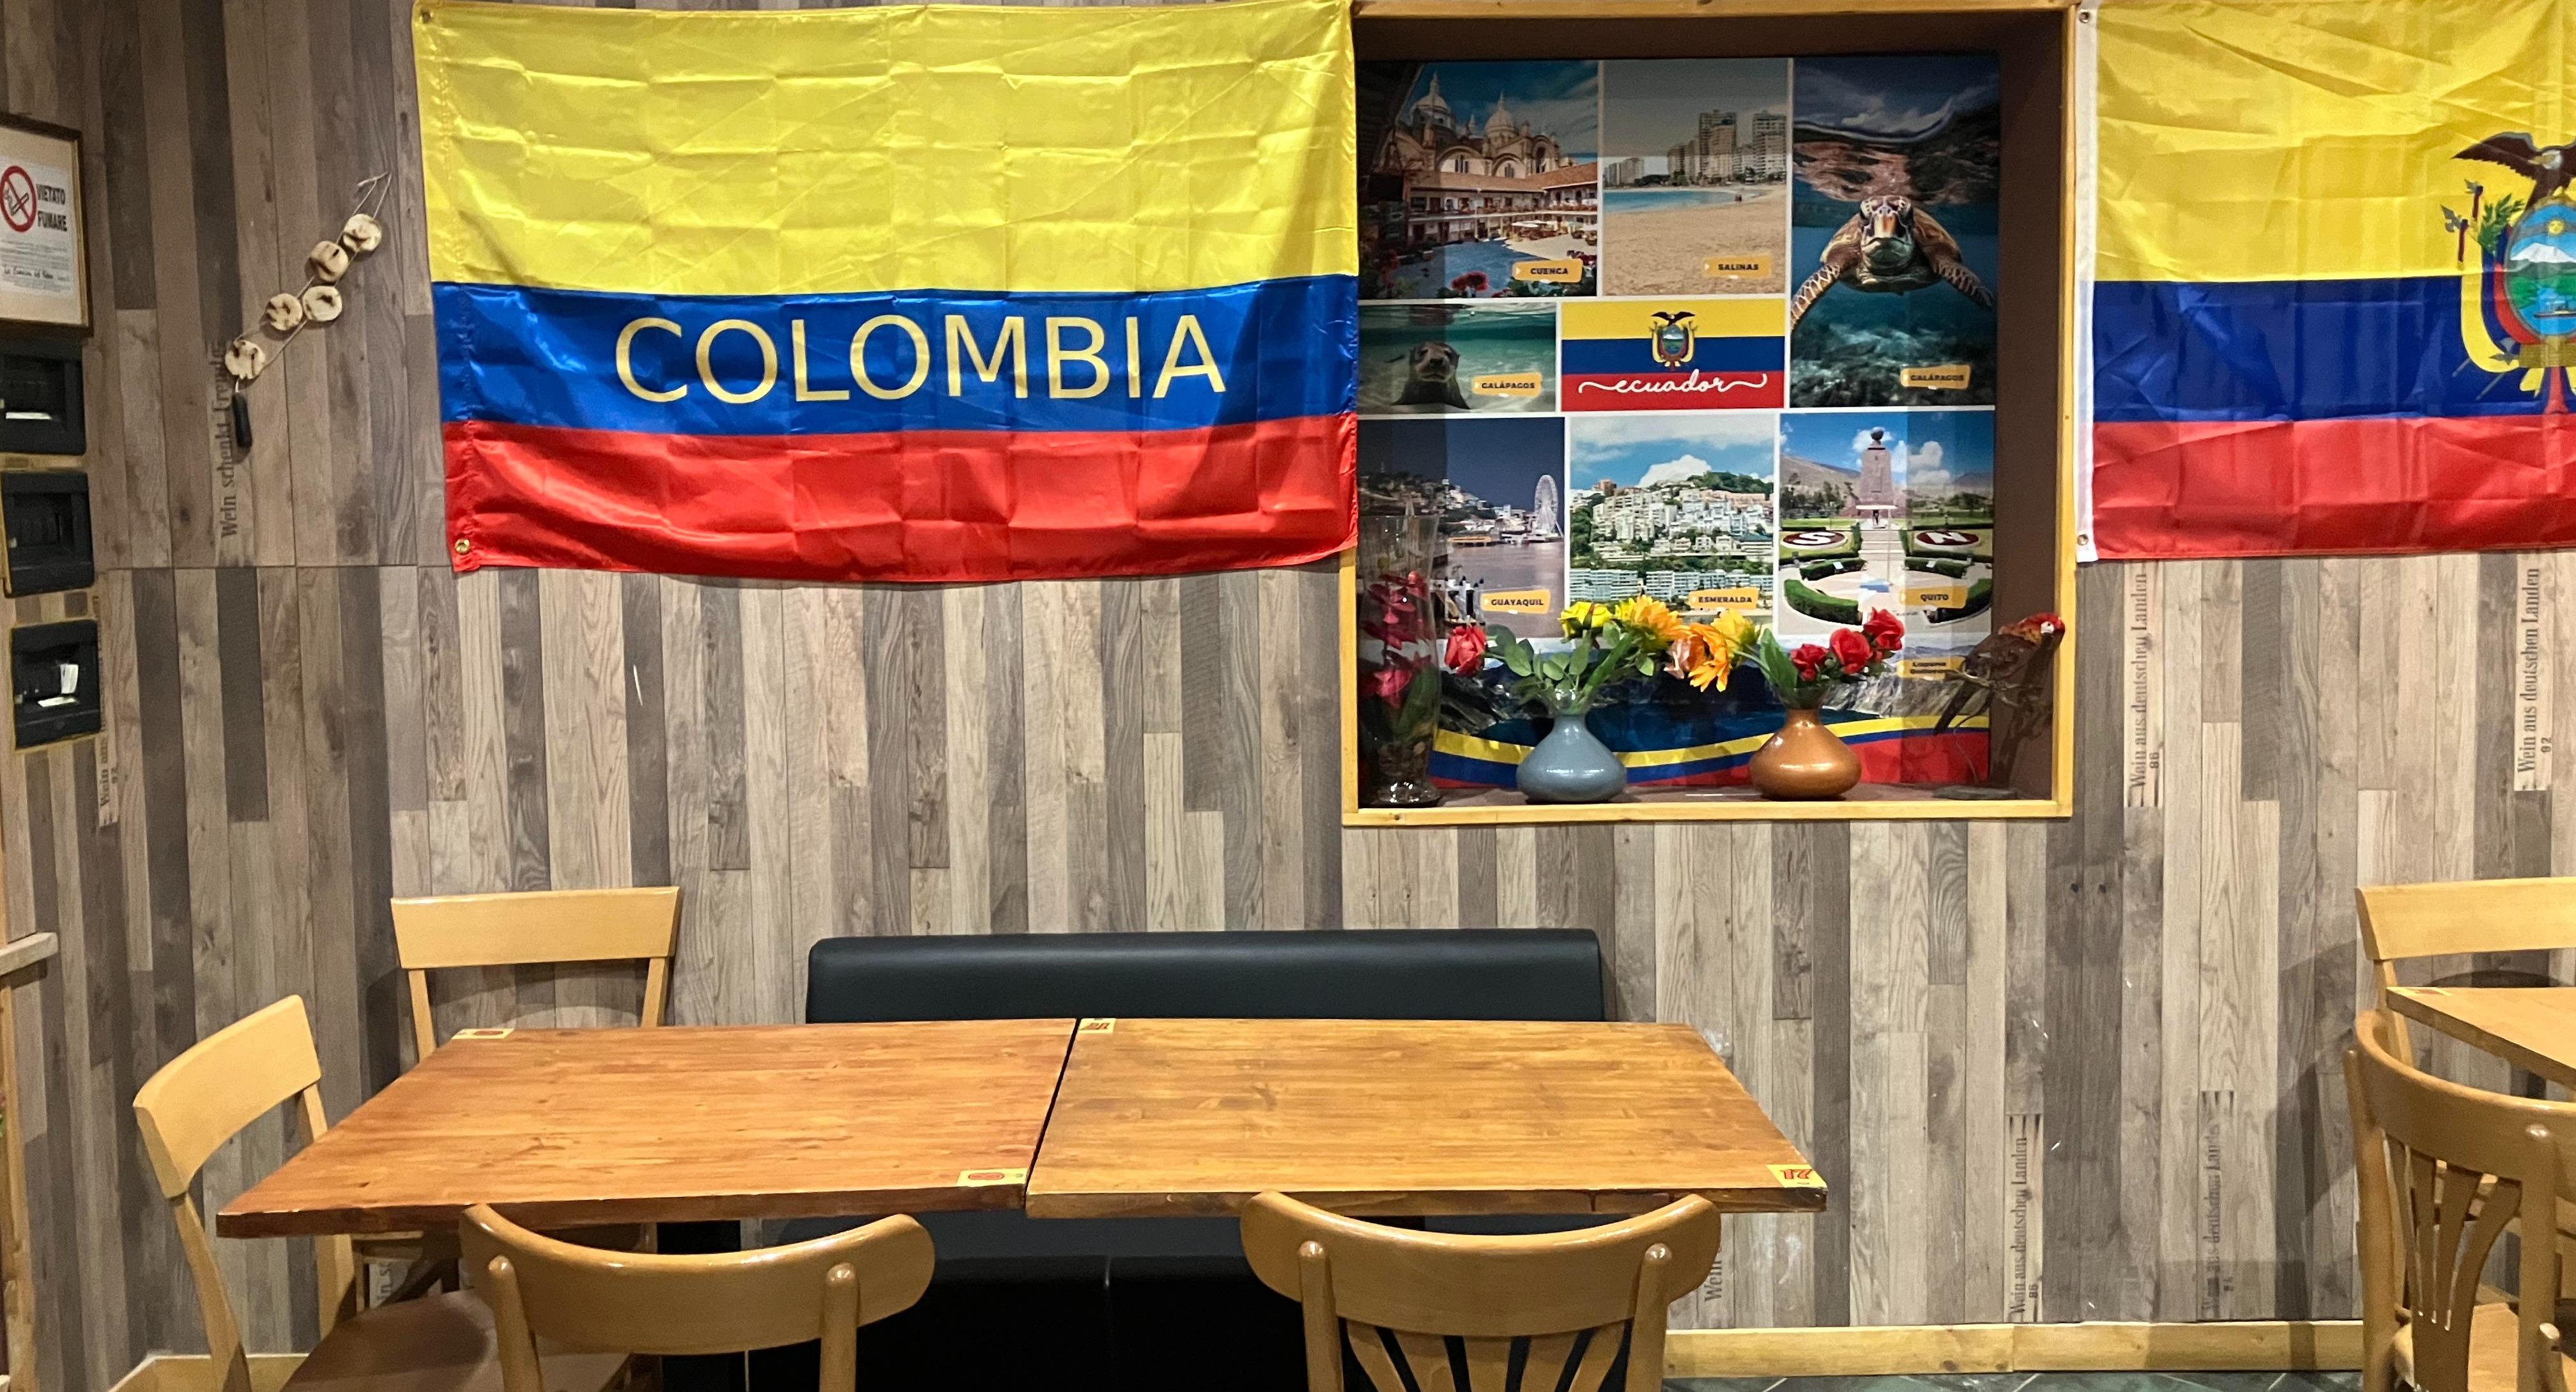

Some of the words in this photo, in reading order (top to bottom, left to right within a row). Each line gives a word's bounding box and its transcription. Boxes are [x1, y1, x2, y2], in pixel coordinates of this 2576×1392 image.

[36, 184, 66, 205] VIETATO
[38, 211, 67, 231] FUMARE
[615, 314, 1227, 404] COLOMBIA
[1578, 369, 1768, 394] ecuador
[220, 494, 238, 538] Wein
[1920, 593, 1949, 602] QUITO
[2130, 574, 2147, 631] Landen
[2521, 569, 2540, 623] Landen
[2131, 637, 2147, 713] deutschen
[2519, 629, 2538, 701] deutschen
[2135, 718, 2147, 746] aus
[2524, 705, 2536, 732] aus
[2129, 751, 2147, 787] Wein
[2517, 736, 2536, 772] Wein
[2011, 1137, 2027, 1184] Landen
